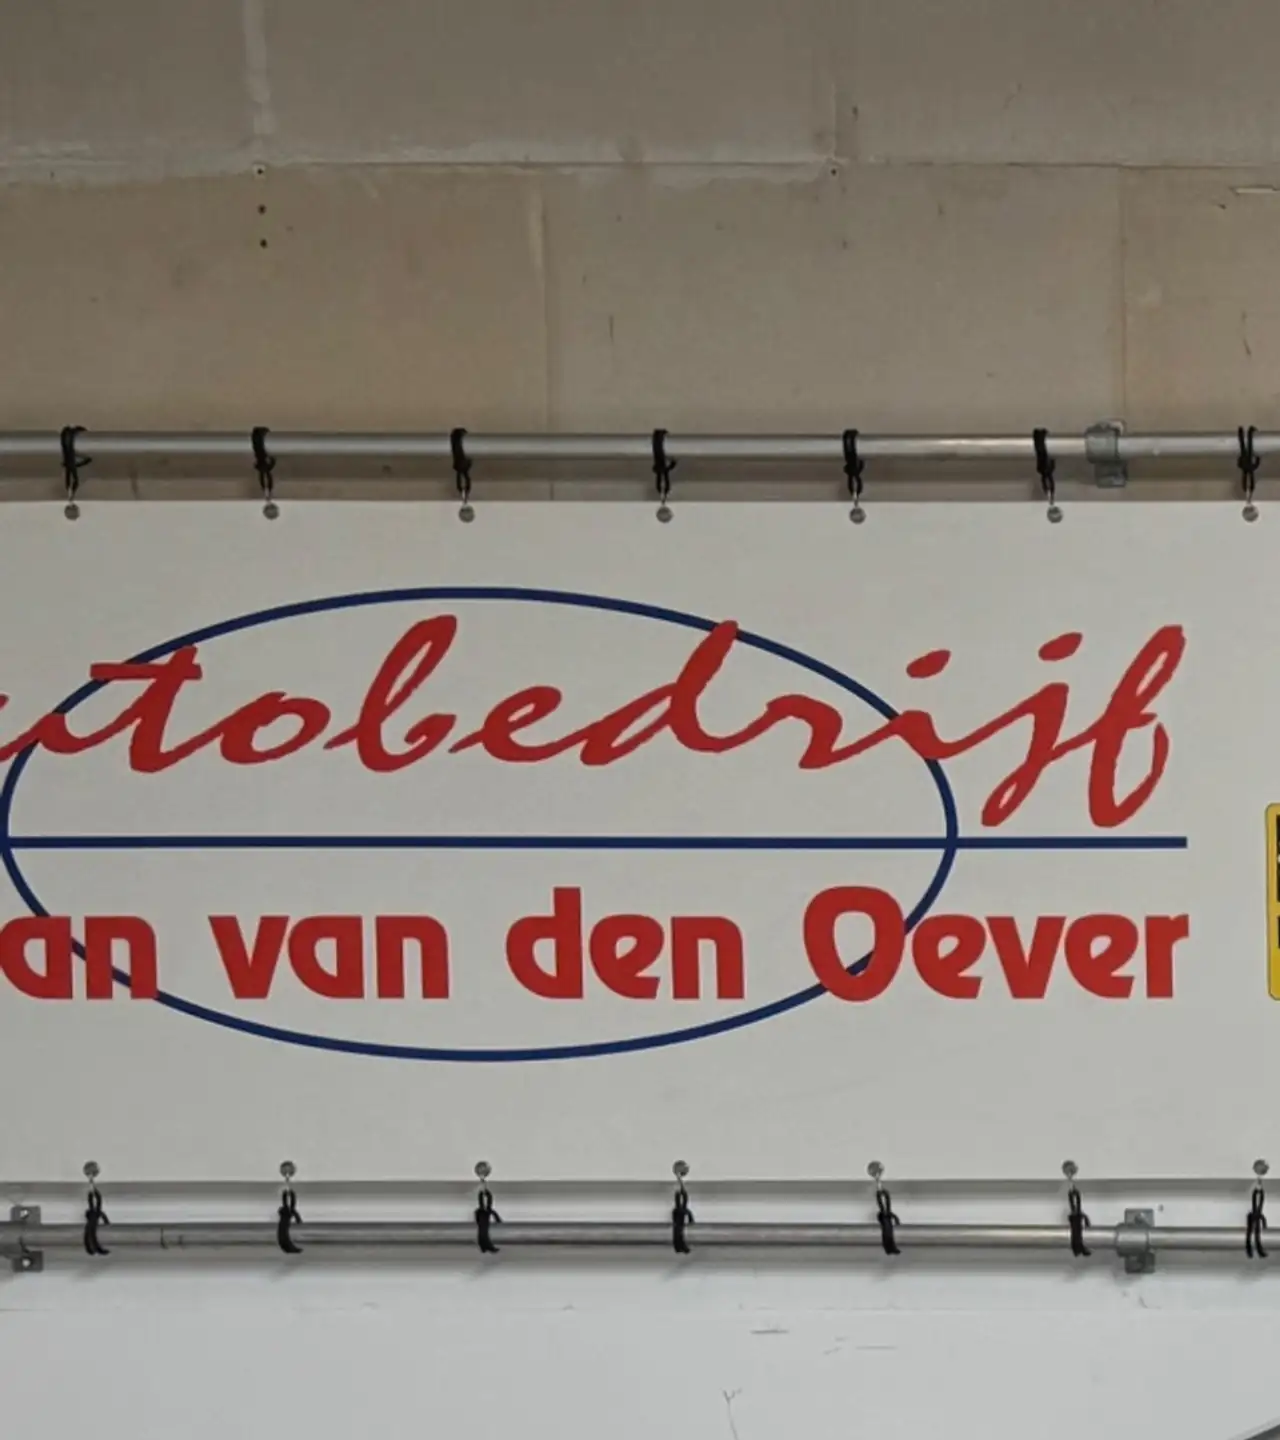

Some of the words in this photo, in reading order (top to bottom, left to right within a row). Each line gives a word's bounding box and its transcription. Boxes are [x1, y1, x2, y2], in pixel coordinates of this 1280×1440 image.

[211, 916, 449, 1000] van
[506, 887, 744, 1000] den
[803, 887, 1189, 1002] Oever
